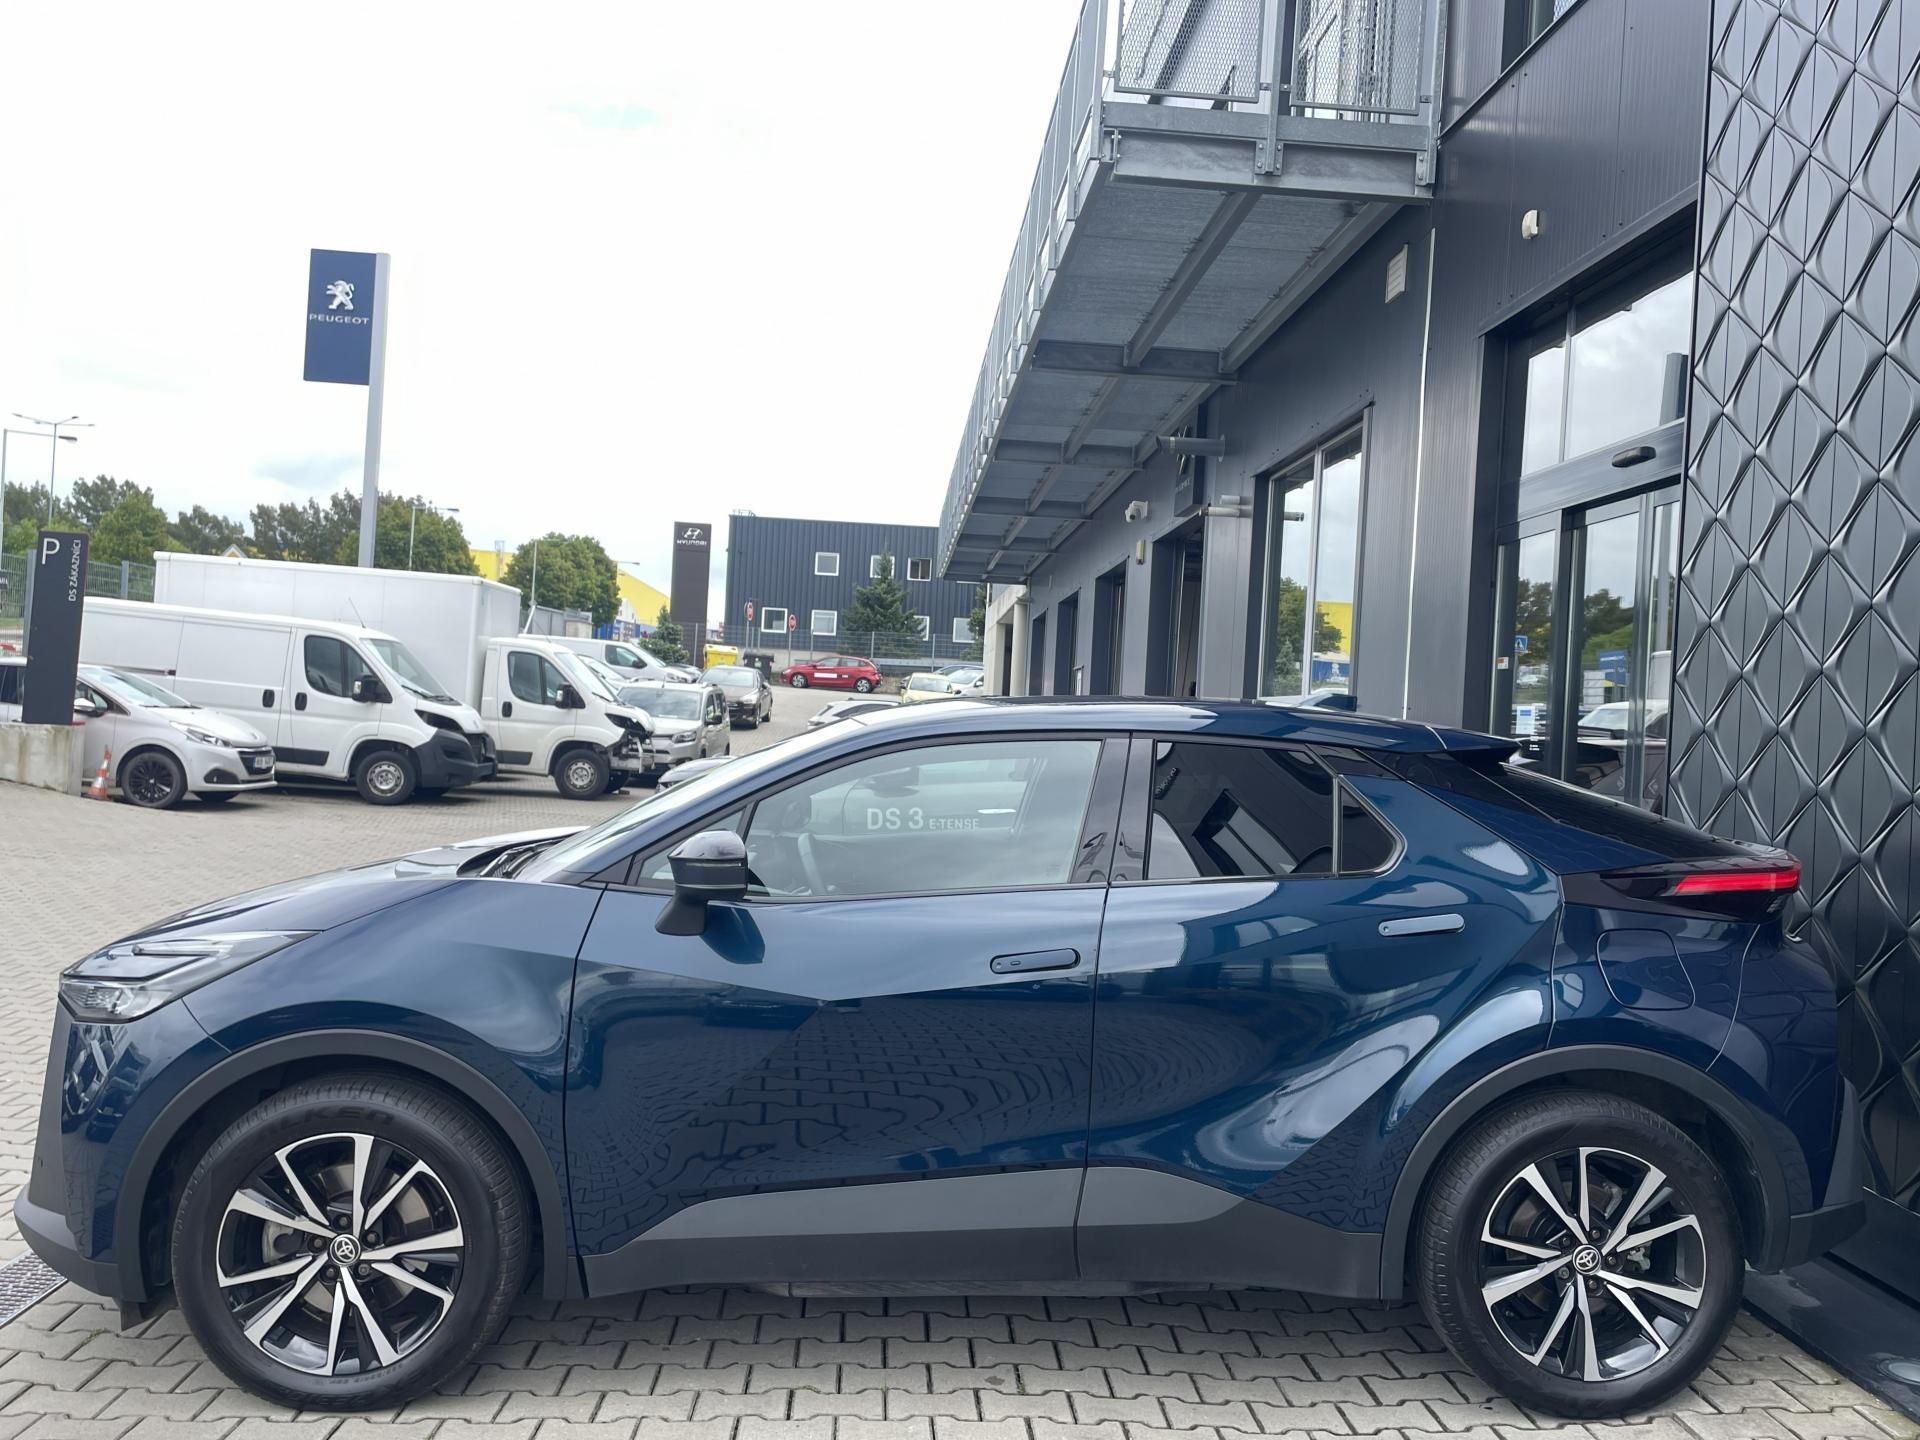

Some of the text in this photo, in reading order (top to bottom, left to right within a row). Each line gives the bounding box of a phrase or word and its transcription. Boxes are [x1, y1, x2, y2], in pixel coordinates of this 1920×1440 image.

[309, 313, 369, 325] PEUGEOT
[41, 537, 60, 565] P
[68, 587, 77, 601] DS
[867, 808, 901, 830] DS
[908, 807, 924, 829] 3
